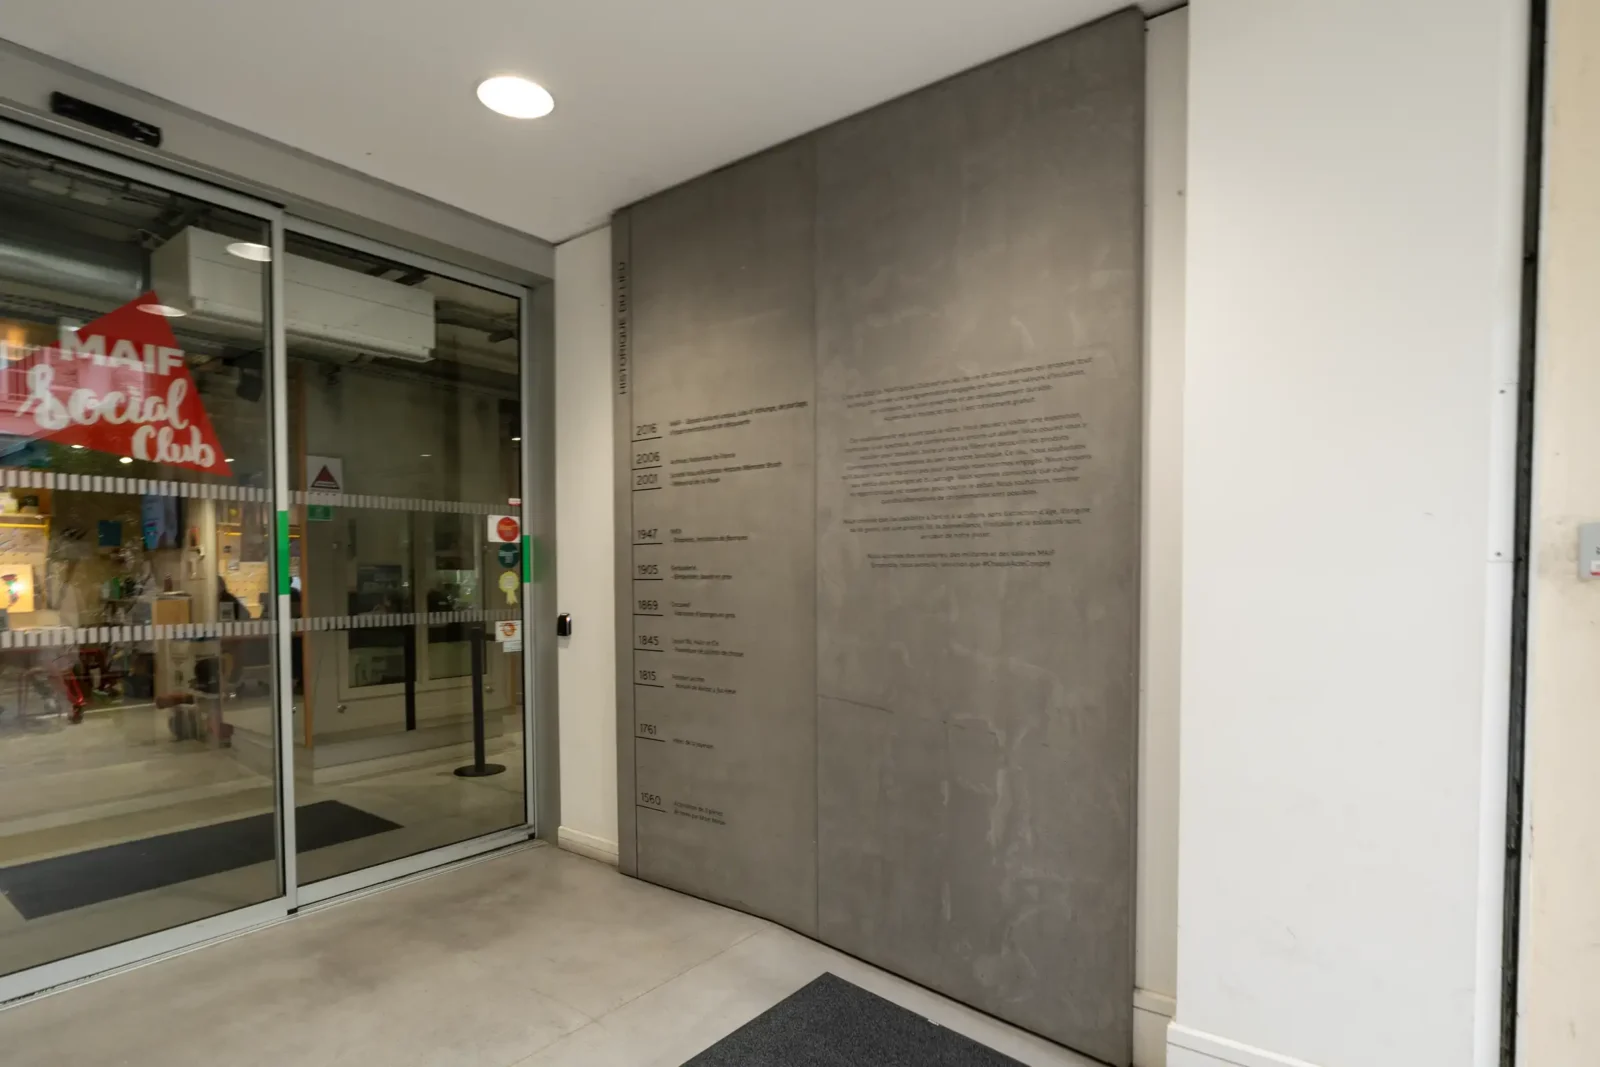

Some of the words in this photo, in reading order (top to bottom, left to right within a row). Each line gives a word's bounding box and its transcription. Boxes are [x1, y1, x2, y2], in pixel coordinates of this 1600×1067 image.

[59, 317, 184, 376] MAIF
[15, 364, 189, 430] Social
[636, 423, 657, 436] 2016
[131, 425, 215, 468] Club
[636, 451, 660, 465] 2006
[636, 473, 658, 486] 2001
[637, 528, 659, 540] 1947
[637, 564, 659, 575] 1905
[638, 599, 659, 611] 1869
[638, 635, 660, 646] 1845
[639, 670, 657, 681] 1815
[640, 723, 657, 735] 1761
[641, 792, 662, 806] 1560
